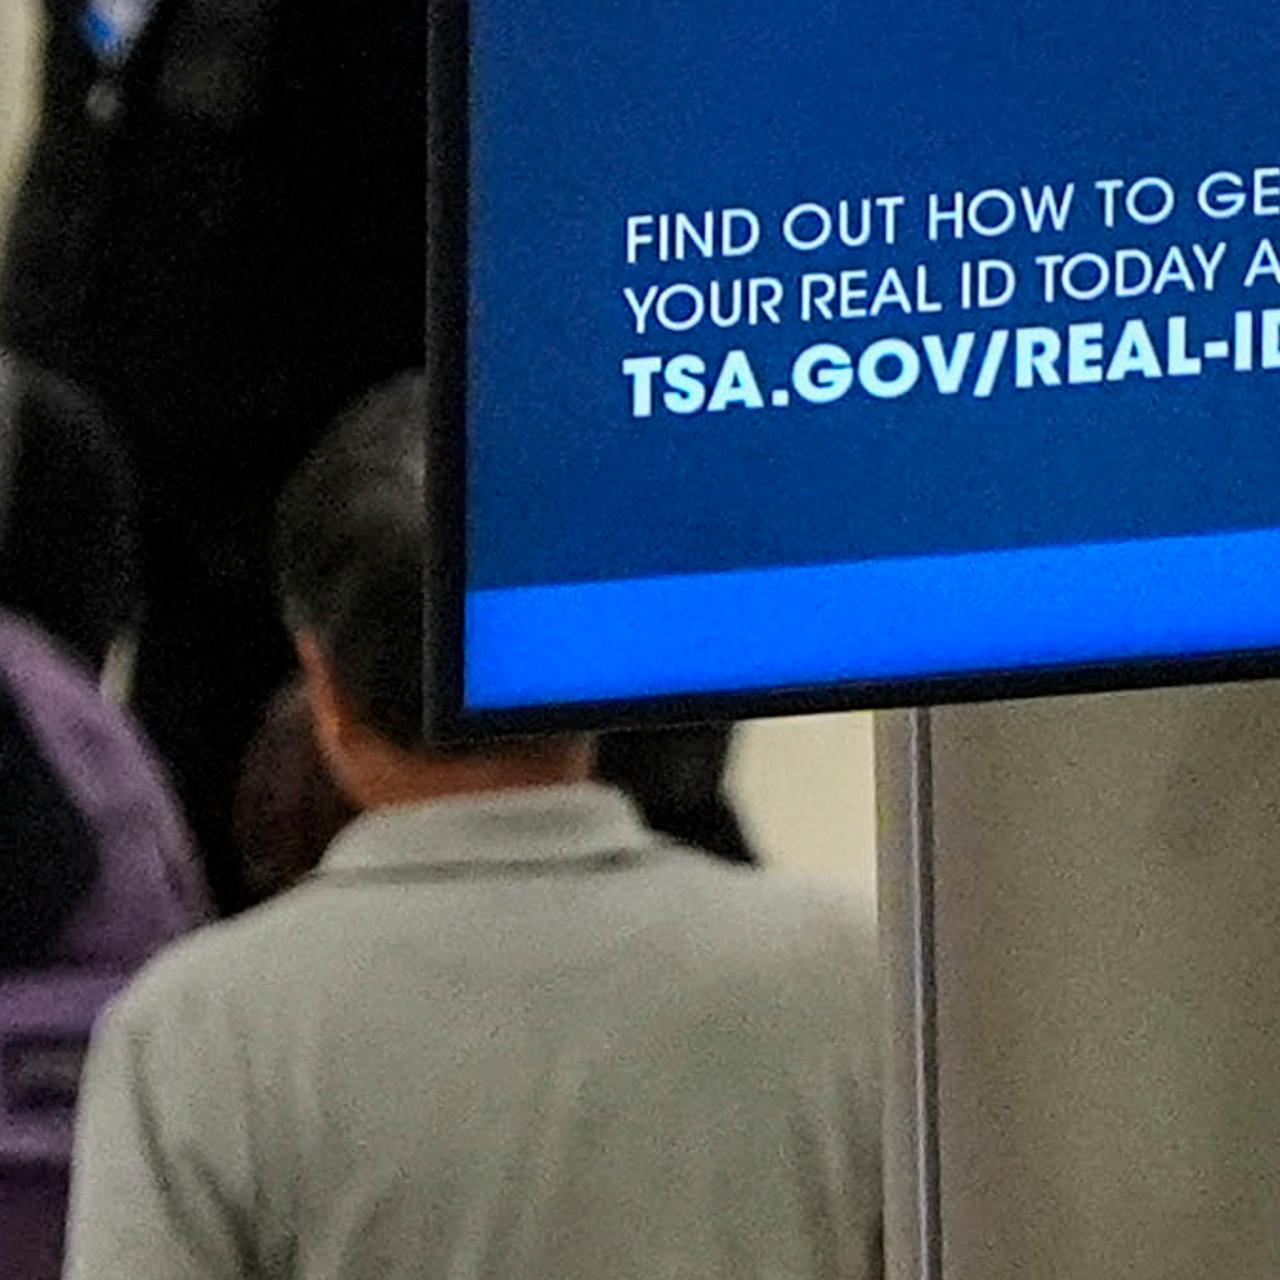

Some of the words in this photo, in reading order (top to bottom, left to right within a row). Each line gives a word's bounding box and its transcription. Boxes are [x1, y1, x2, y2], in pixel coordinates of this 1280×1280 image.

[626, 208, 761, 264] FIND
[782, 195, 905, 251] OUT
[928, 182, 1075, 242] HOW
[1095, 176, 1175, 228] TO
[623, 276, 784, 335] YOUR
[801, 264, 943, 322] REAL
[961, 259, 1016, 310] ID
[1035, 241, 1227, 303] TODAY
